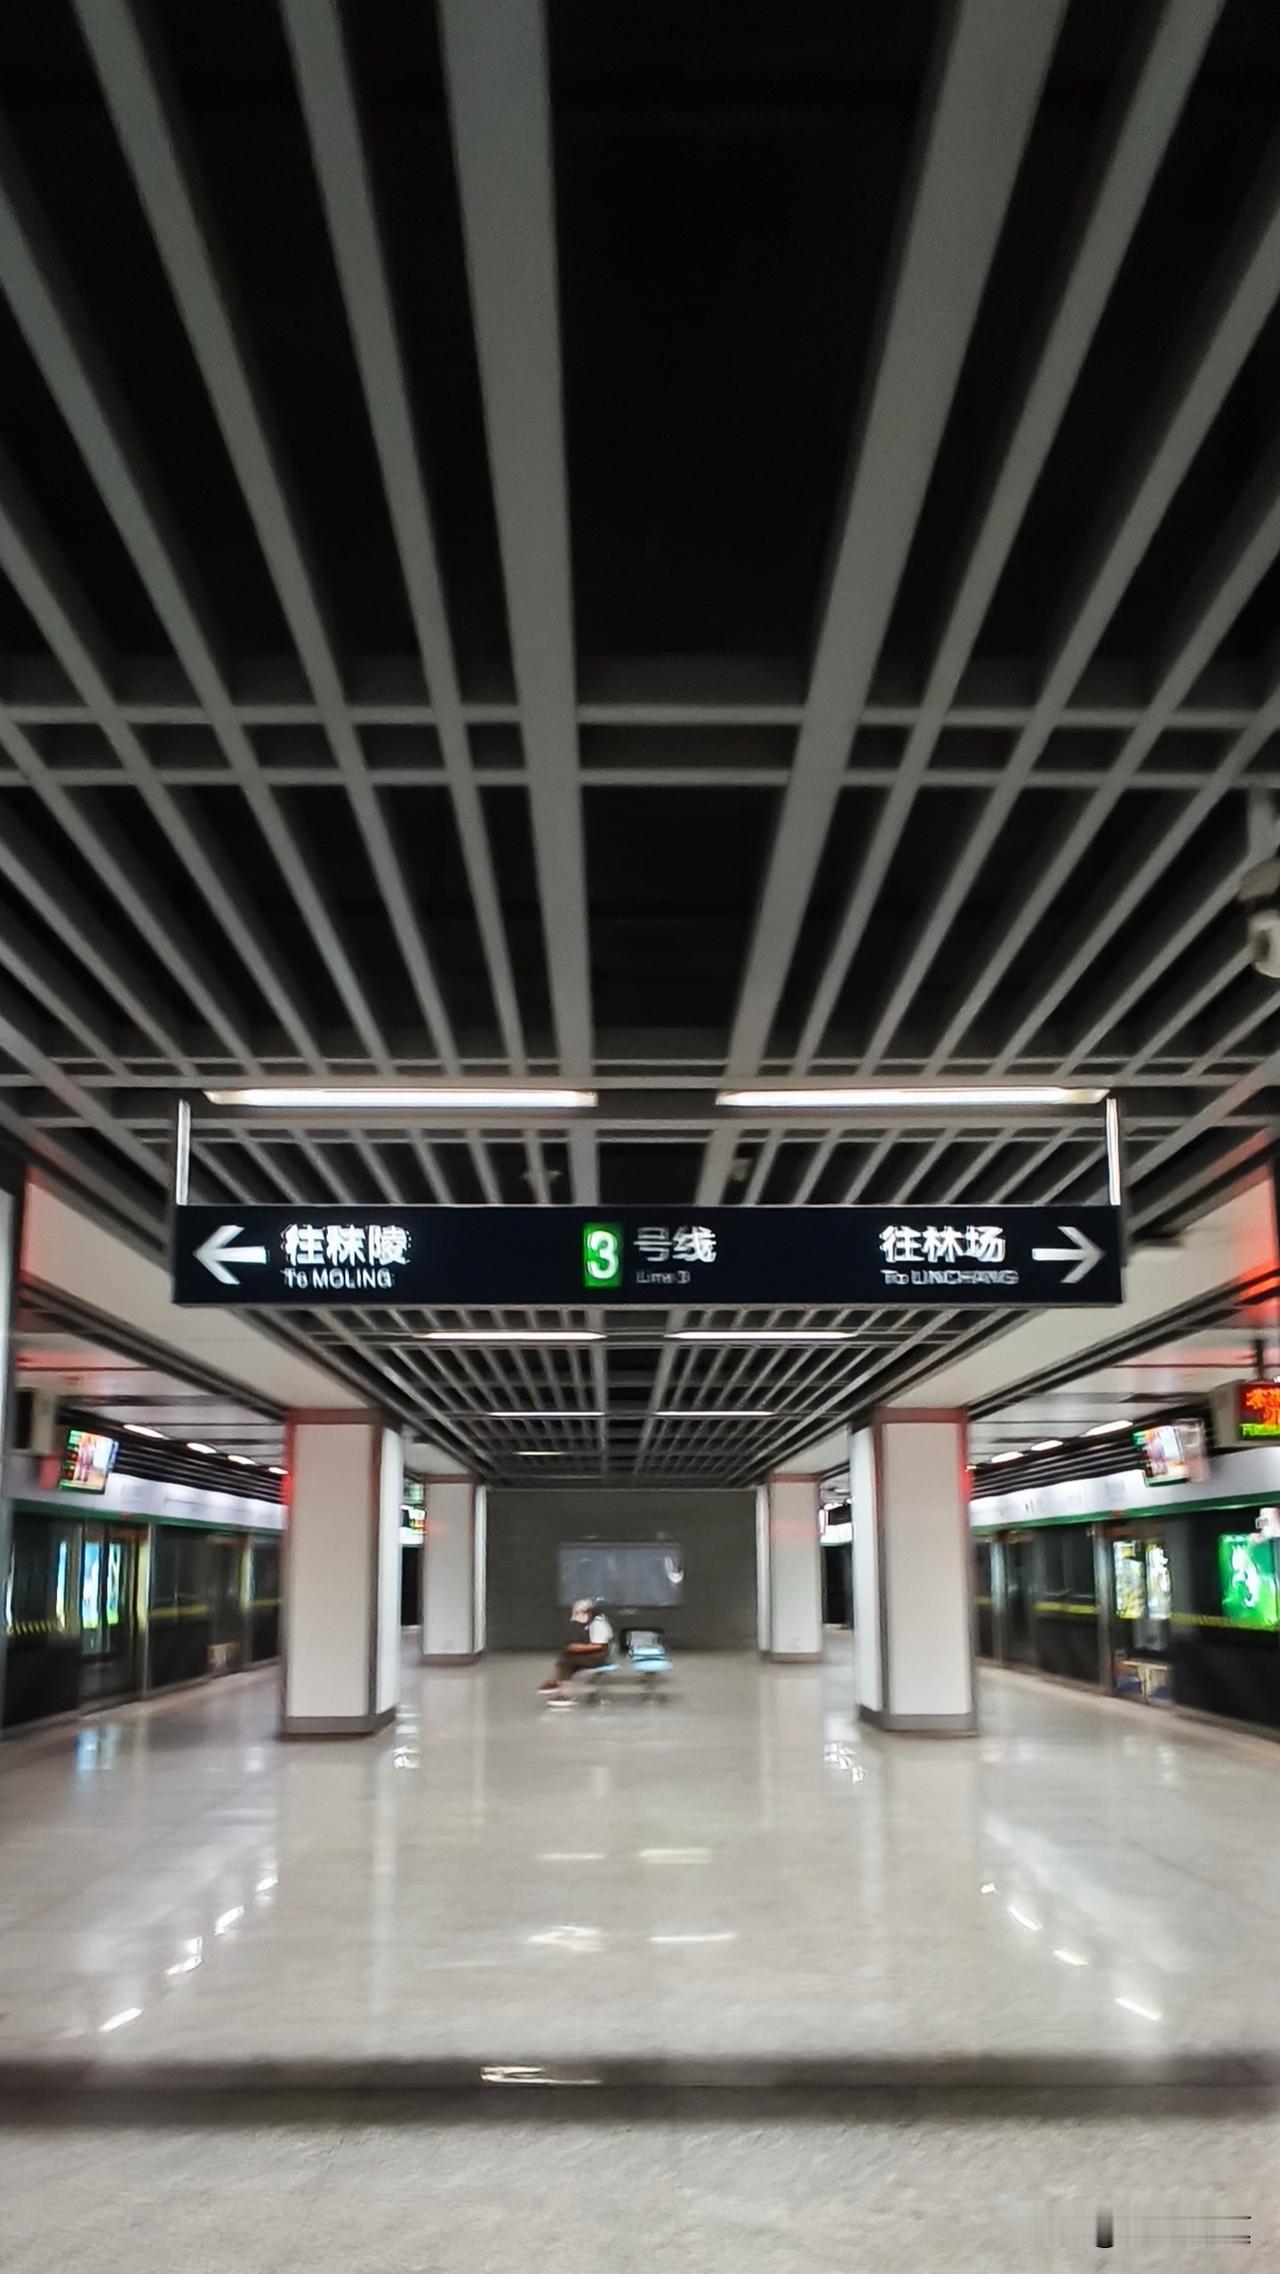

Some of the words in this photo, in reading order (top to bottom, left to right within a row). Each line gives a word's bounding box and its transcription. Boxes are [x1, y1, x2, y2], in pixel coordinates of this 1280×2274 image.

[282, 1224, 410, 1266] 往秣陵
[587, 1231, 618, 1279] 3
[633, 1226, 717, 1262] 号线
[879, 1225, 1006, 1262] 往林场
[281, 1268, 308, 1289] To
[312, 1267, 394, 1289] MOLING
[881, 1269, 909, 1285] To
[911, 1269, 1019, 1285] LINCHANG
